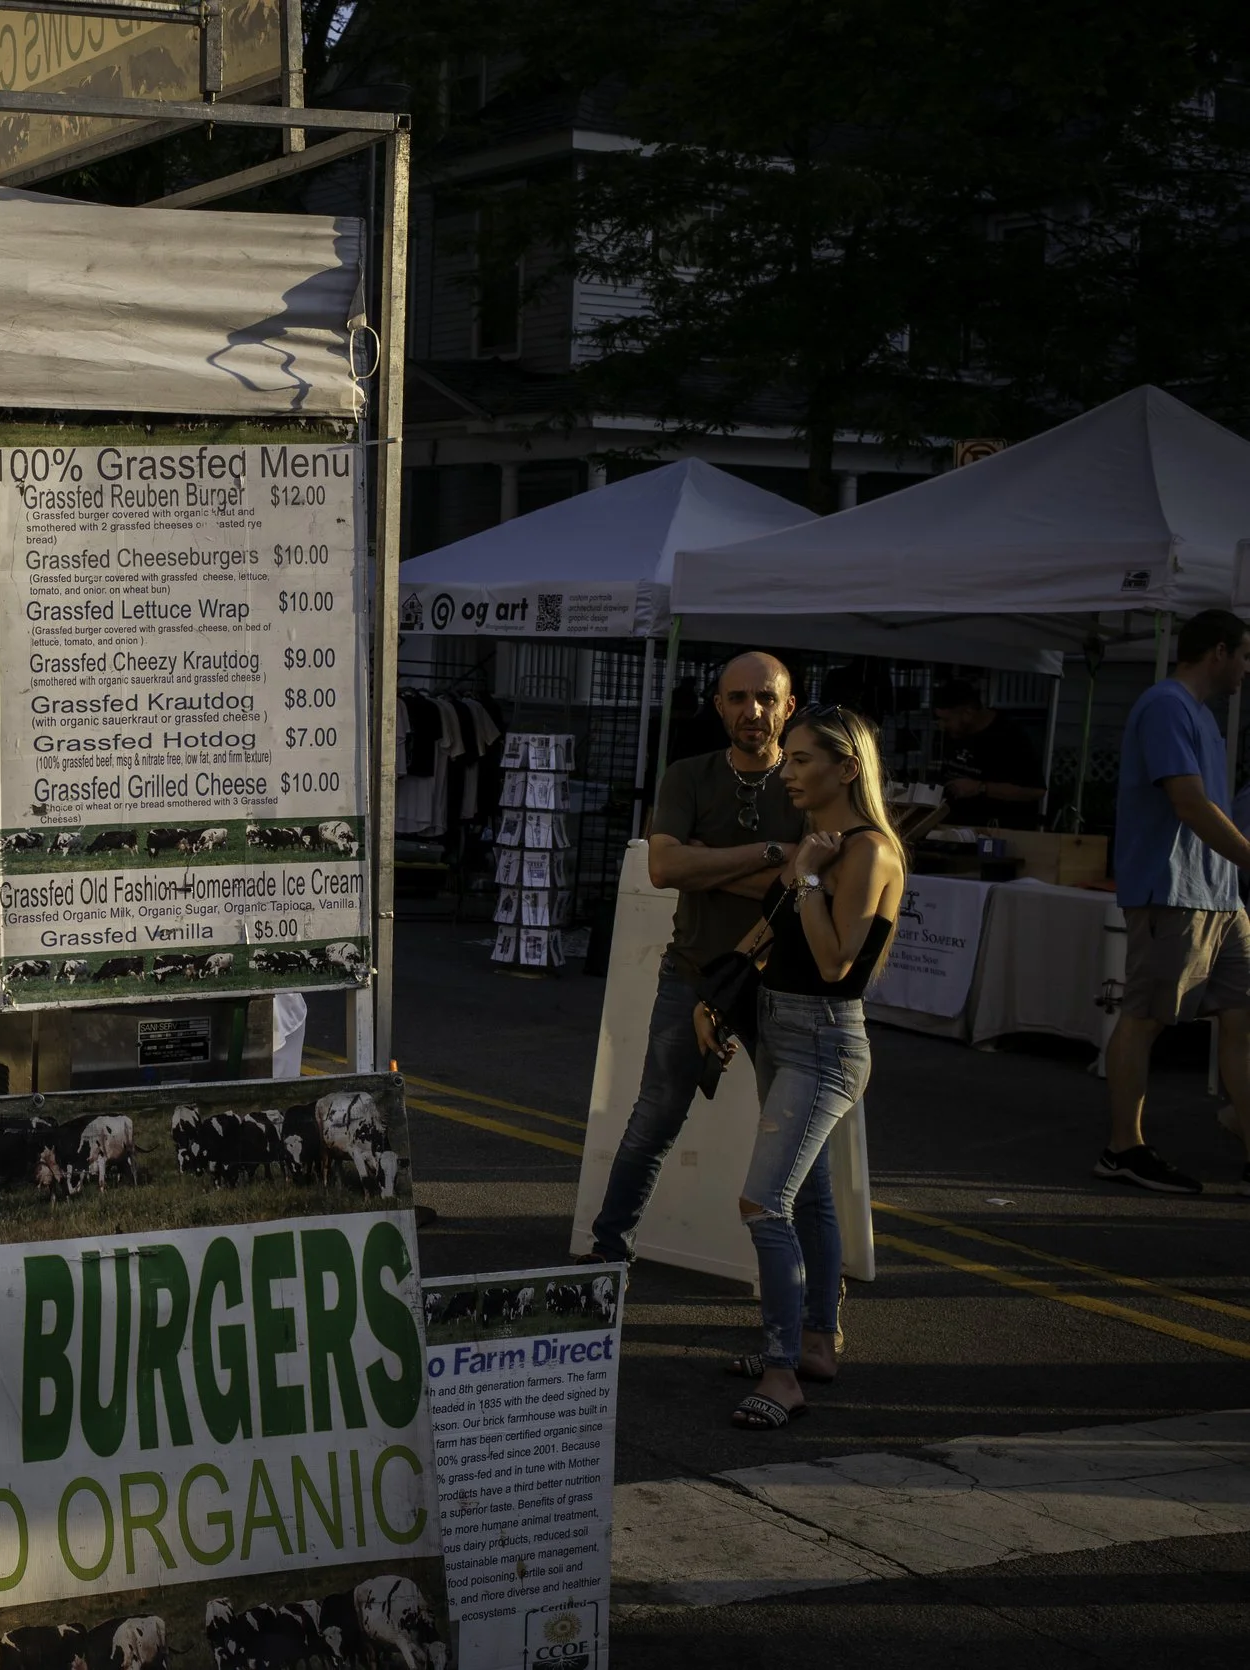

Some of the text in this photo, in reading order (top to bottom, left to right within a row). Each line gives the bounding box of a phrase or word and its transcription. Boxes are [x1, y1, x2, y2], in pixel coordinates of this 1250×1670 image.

[97, 447, 246, 480] Grassfed
[261, 447, 349, 478] Menu
[24, 482, 325, 511] Grassfed Reuben Burger $12.00
[32, 508, 255, 520] Grassfed burger covered with organic and
[27, 522, 192, 532] smothered with 2 grassfed cheeses
[26, 536, 57, 545] bread)
[26, 544, 328, 569] Grassfed Cheeseburgers $10.00
[29, 572, 270, 584] (Grassfed covered with grassfed cheese, lettuce,
[26, 590, 333, 622] Grassfed Lettuce Wrap $10.00
[462, 601, 489, 627] og
[496, 598, 528, 620] art
[31, 626, 72, 636] (Grassfed
[75, 627, 101, 635] burger
[104, 625, 136, 633] covered
[158, 624, 193, 634] grassfed
[263, 623, 271, 631] of
[64, 638, 94, 646] tomato,
[98, 637, 112, 645] and
[115, 637, 138, 645] onion
[30, 647, 335, 674] Grassfed Cheezy Krautdog $9.00
[31, 672, 260, 689] (smothered with organic sauerkraut and grassfed cheese
[31, 688, 336, 714] Grassfed Krautdog $8.00
[32, 712, 260, 729] (with organic sauerkraut or grassfed cheese
[34, 727, 337, 752] Grassfed Hotdog $7.00
[34, 771, 339, 802] Grassfed Grilled Cheese $10.00
[0, 869, 364, 908] Grassfed Old Fashion Homemade Ice Cream
[4, 900, 315, 926] (Grassfed Organic Milk, Organic Sugar, Organic Tapioca,
[41, 919, 298, 946] Grassfed Vanilla $5.00
[23, 1221, 422, 1463] BURGERS
[454, 1335, 613, 1375] Farm Direct
[439, 1371, 606, 1397] and 8th generation farmers. The farm
[467, 1387, 610, 1410] in 1835 with the deed signed by
[463, 1404, 607, 1428] Our brick farmhouse was built in
[436, 1422, 603, 1449] farm has been certified organic since
[461, 1440, 600, 1465] grass-fed since 2001. Because
[58, 1444, 428, 1582] ORGANIC
[462, 1606, 516, 1622] ecosystems
[536, 1641, 588, 1660] CCOF
